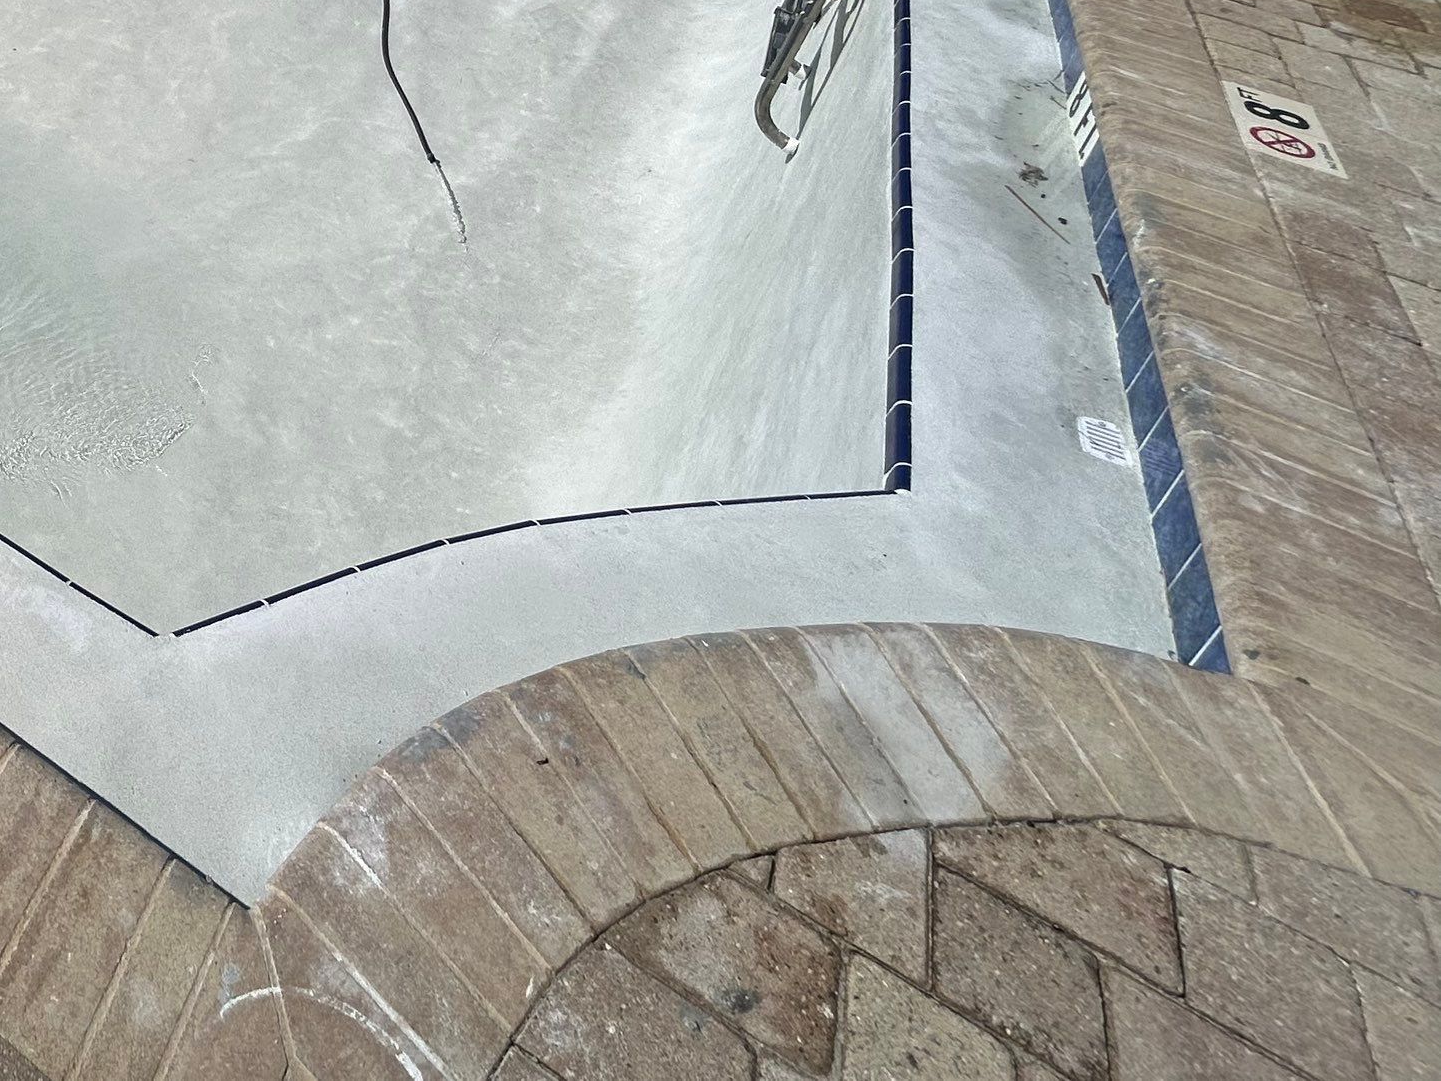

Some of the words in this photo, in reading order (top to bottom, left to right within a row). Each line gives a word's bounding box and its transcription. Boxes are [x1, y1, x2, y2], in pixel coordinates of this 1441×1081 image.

[1069, 79, 1089, 118] 8
[1236, 86, 1263, 103] FT
[1244, 100, 1310, 130] 8
